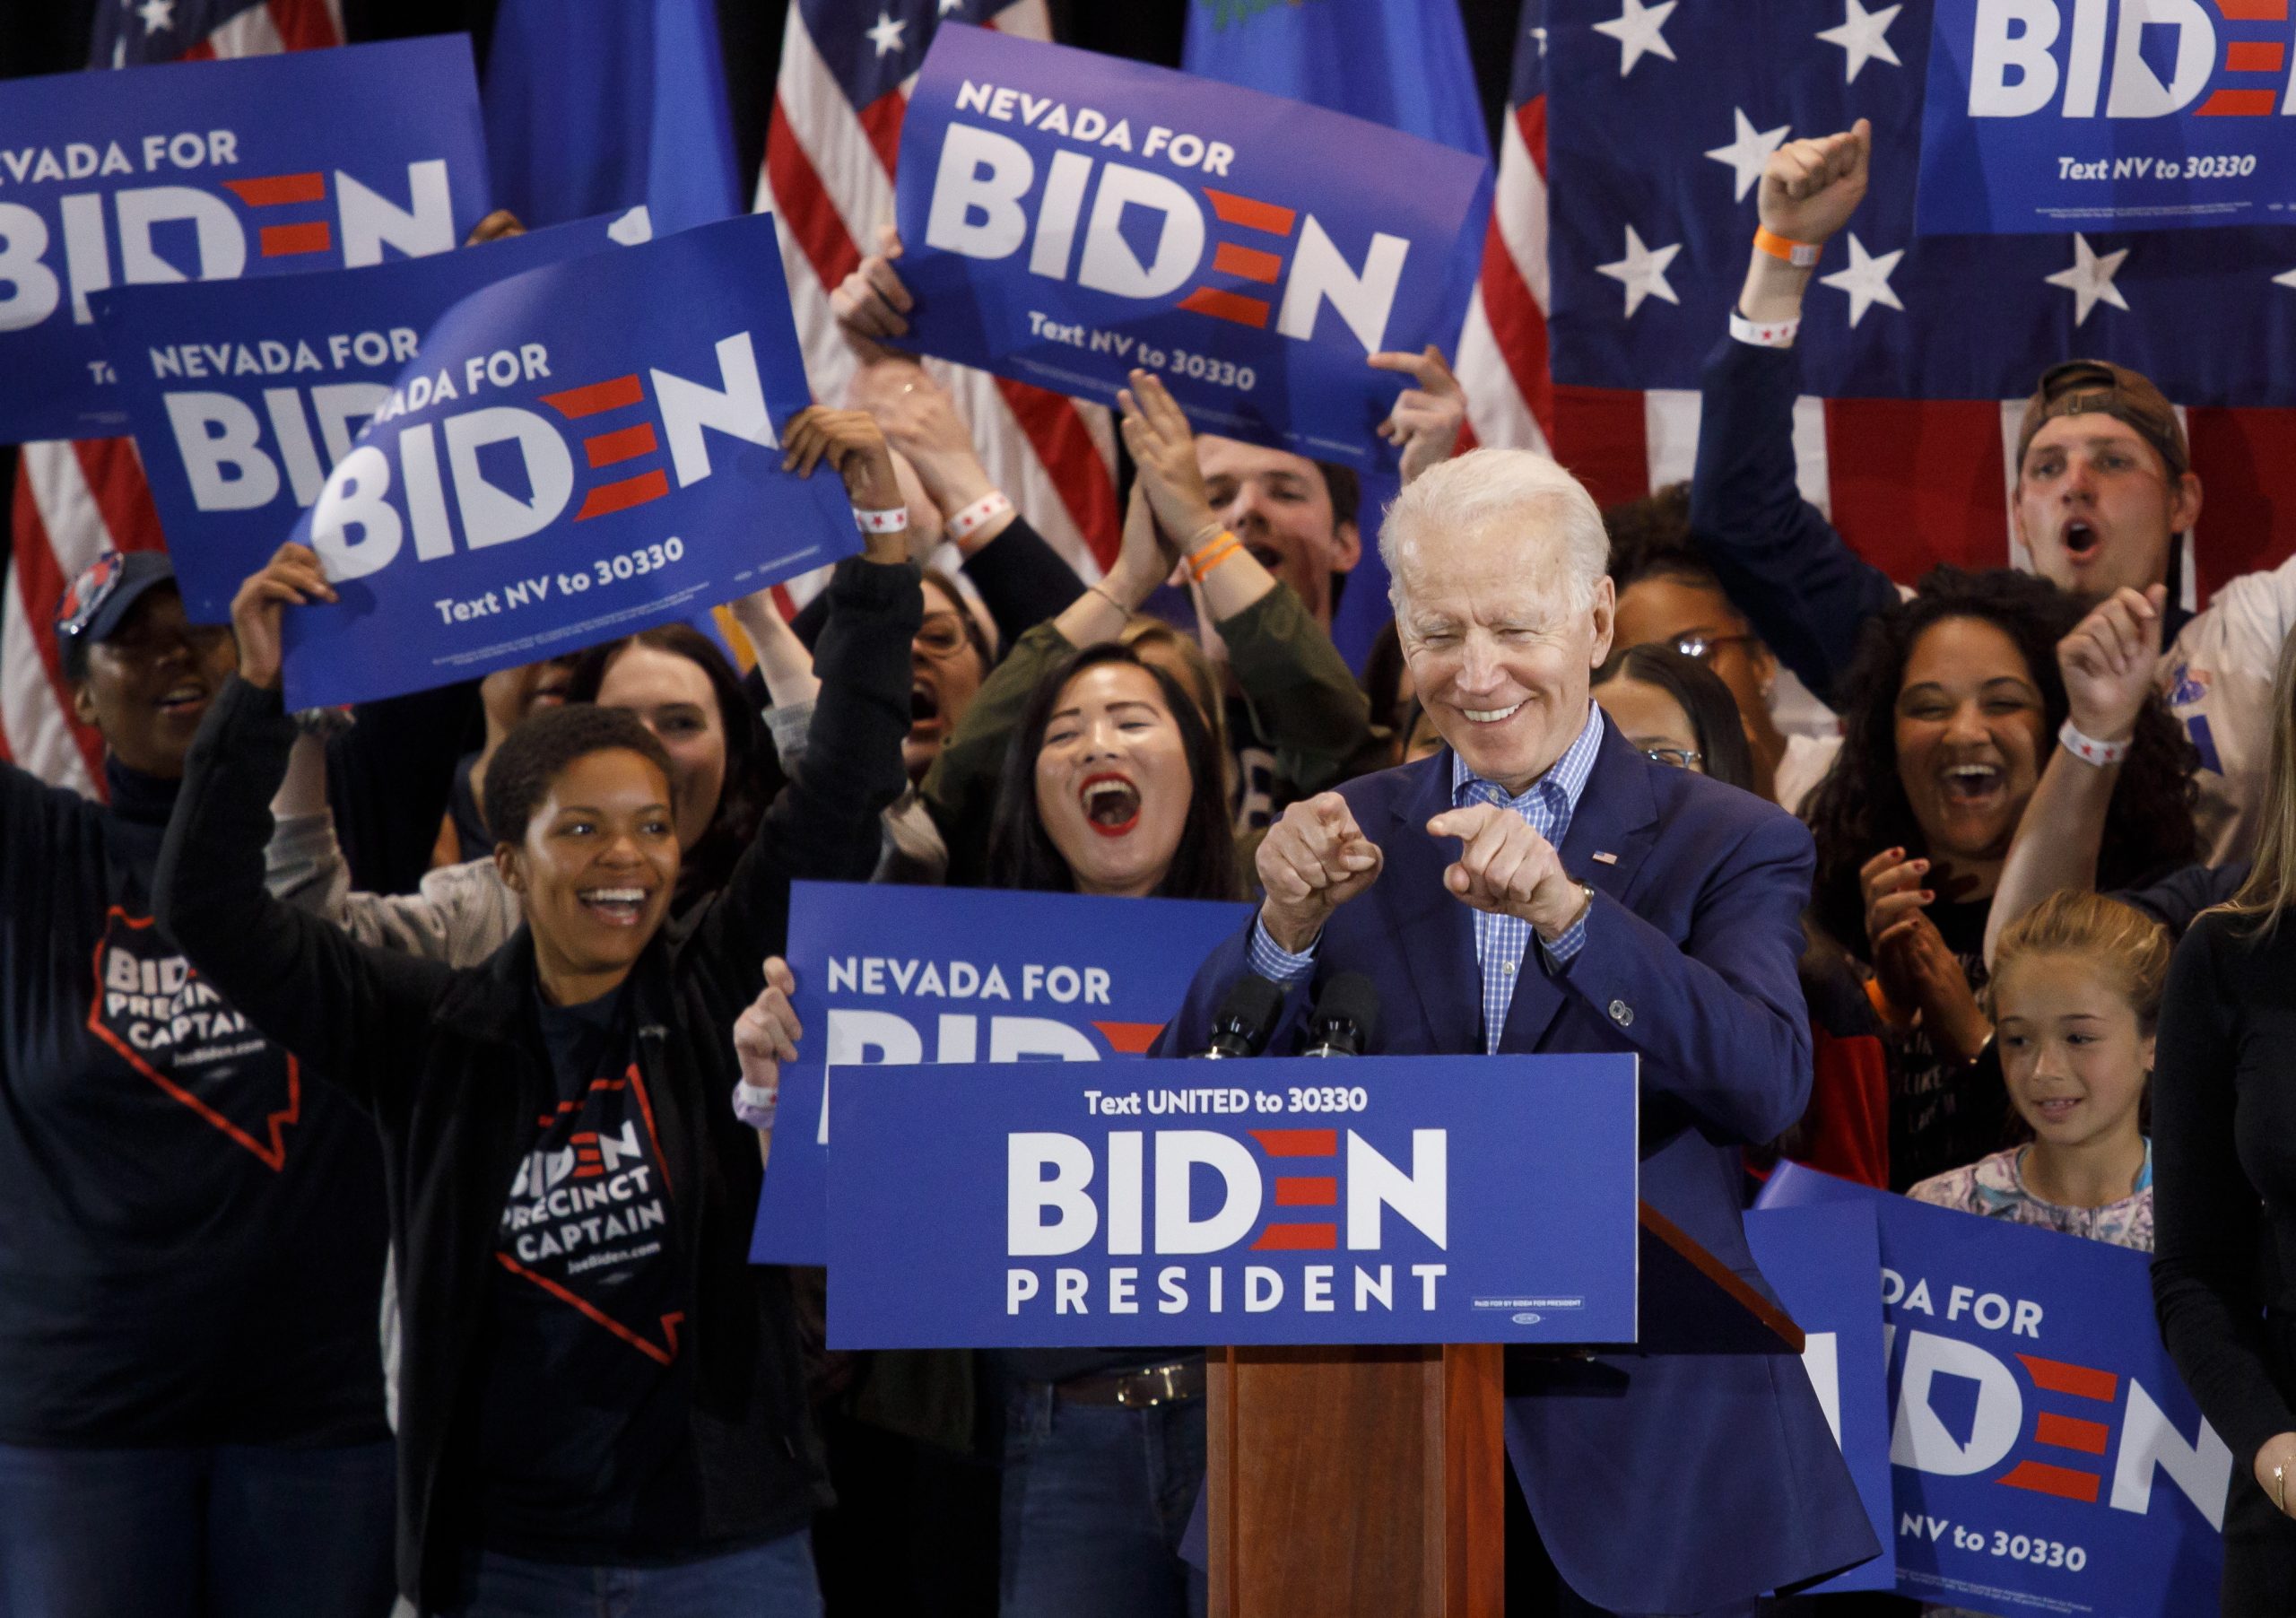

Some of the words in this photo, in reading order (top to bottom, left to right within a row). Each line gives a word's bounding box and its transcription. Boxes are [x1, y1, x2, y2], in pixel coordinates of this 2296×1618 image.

[1968, 0, 2296, 117] BIDE
[0, 141, 134, 185] VADA
[144, 129, 239, 172] FOR
[955, 80, 1133, 153] NEVADA
[1143, 126, 1236, 177] FOR
[2058, 157, 2108, 179] Text
[2112, 157, 2152, 179] NV
[2155, 159, 2180, 179] to
[2182, 154, 2257, 179] 30330
[925, 121, 1411, 356] BIDEN
[149, 338, 324, 379] NEVADA
[328, 327, 421, 370] FOR
[465, 343, 552, 395] FOR
[1028, 311, 1085, 349] Text
[1089, 329, 1132, 358] NV
[1137, 344, 1167, 369] to
[1170, 351, 1257, 392] 30330
[310, 330, 779, 584] BIDEN
[434, 592, 501, 625] Text
[504, 575, 550, 610] NV
[556, 570, 590, 596] to
[594, 536, 685, 587] 30330
[106, 947, 197, 996] BID
[828, 957, 1011, 1000] NEVADA
[1023, 965, 1110, 1005] FOR
[1084, 1091, 1142, 1115] Text
[1147, 1088, 1250, 1114] UNITED
[1255, 1090, 1283, 1114] to
[1287, 1087, 1368, 1113] 30330
[1008, 1128, 1447, 1256] BIDEN
[517, 1199, 665, 1262] CAPTAIN
[1007, 1265, 1447, 1315] PRESIDENT
[1947, 1284, 2044, 1339] FOR
[1883, 1324, 2233, 1533] DEN
[1900, 1512, 1951, 1544] NV
[1953, 1524, 1985, 1552] to
[1990, 1530, 2086, 1572] 30330
